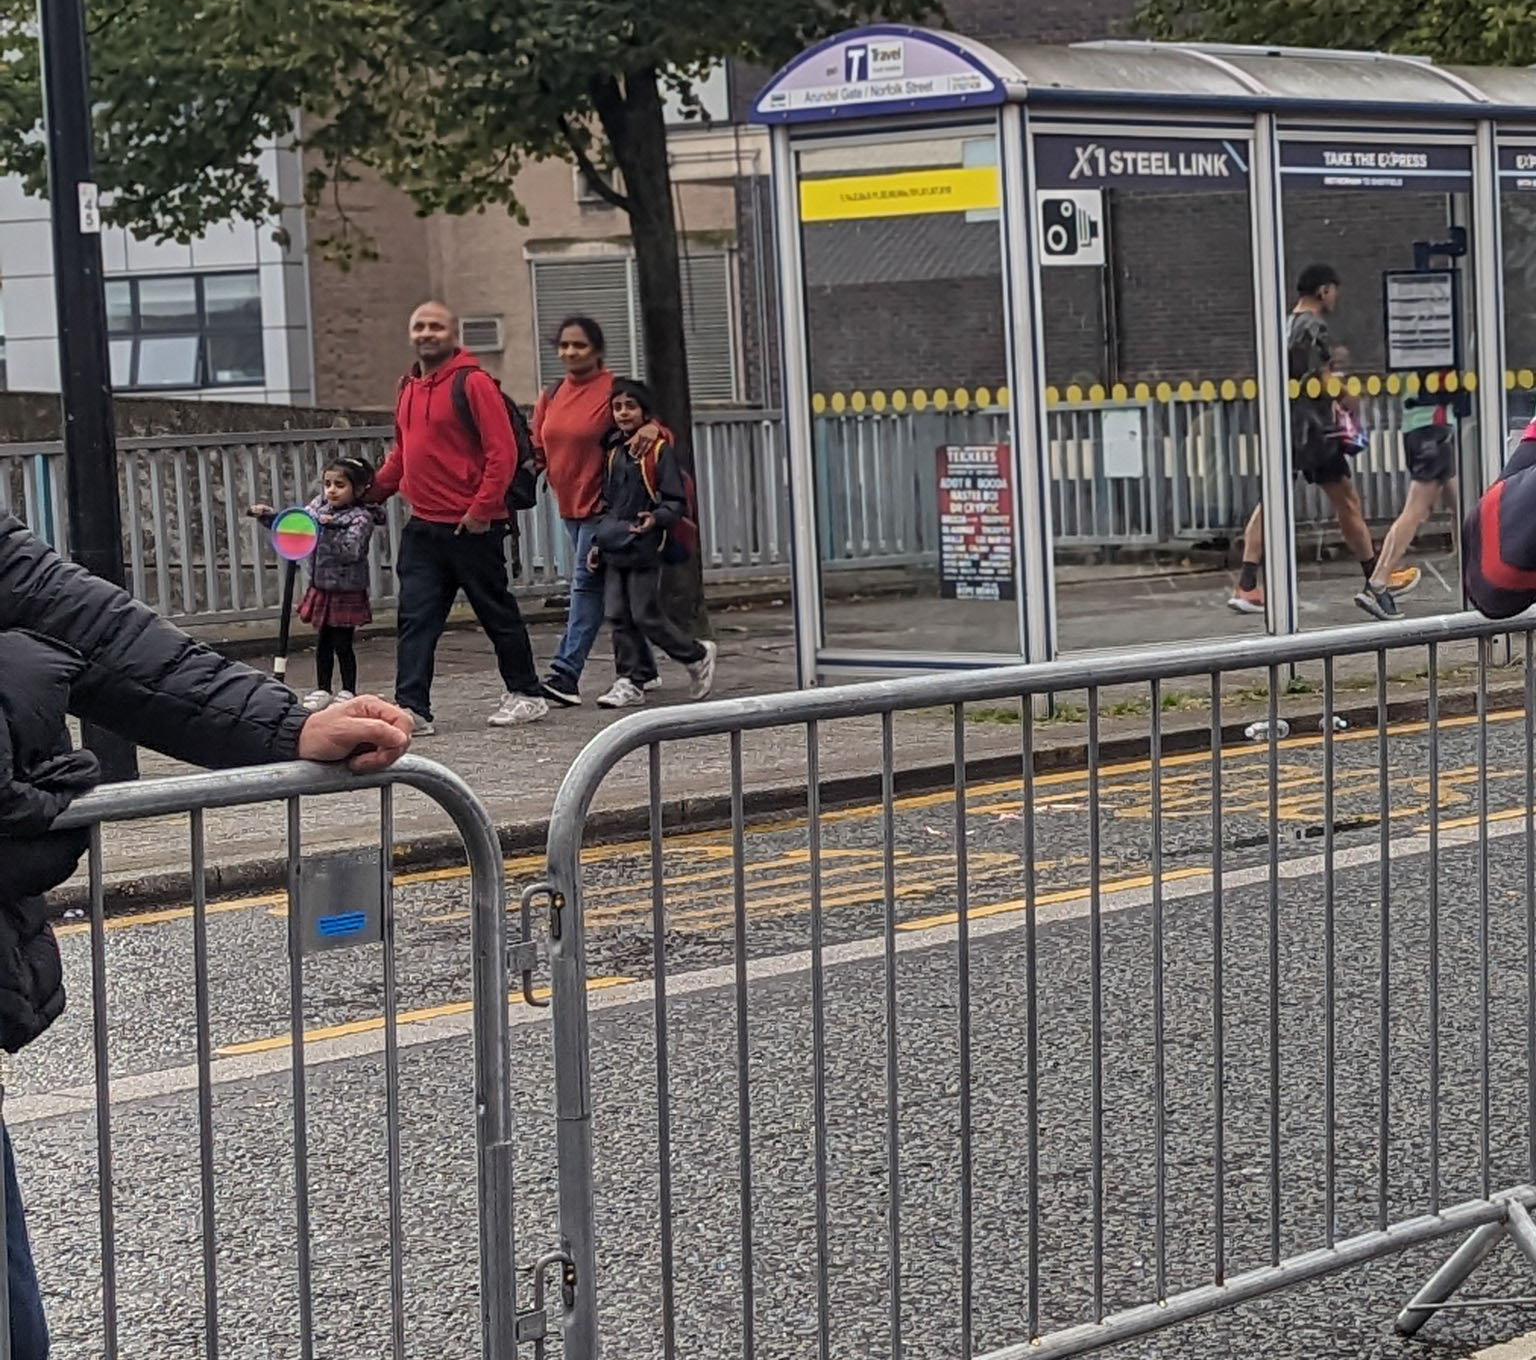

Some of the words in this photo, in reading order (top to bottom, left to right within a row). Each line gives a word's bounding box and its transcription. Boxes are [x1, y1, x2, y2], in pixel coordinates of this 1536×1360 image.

[871, 47, 901, 62] Travel
[804, 89, 839, 103] Arundel
[841, 87, 863, 100] Gate
[870, 83, 903, 97] Norfolk
[905, 80, 933, 94] Street
[1068, 143, 1107, 180] X1
[1323, 151, 1353, 166] TAKE
[1354, 152, 1376, 167] THE
[1377, 151, 1428, 168] EXPRESS
